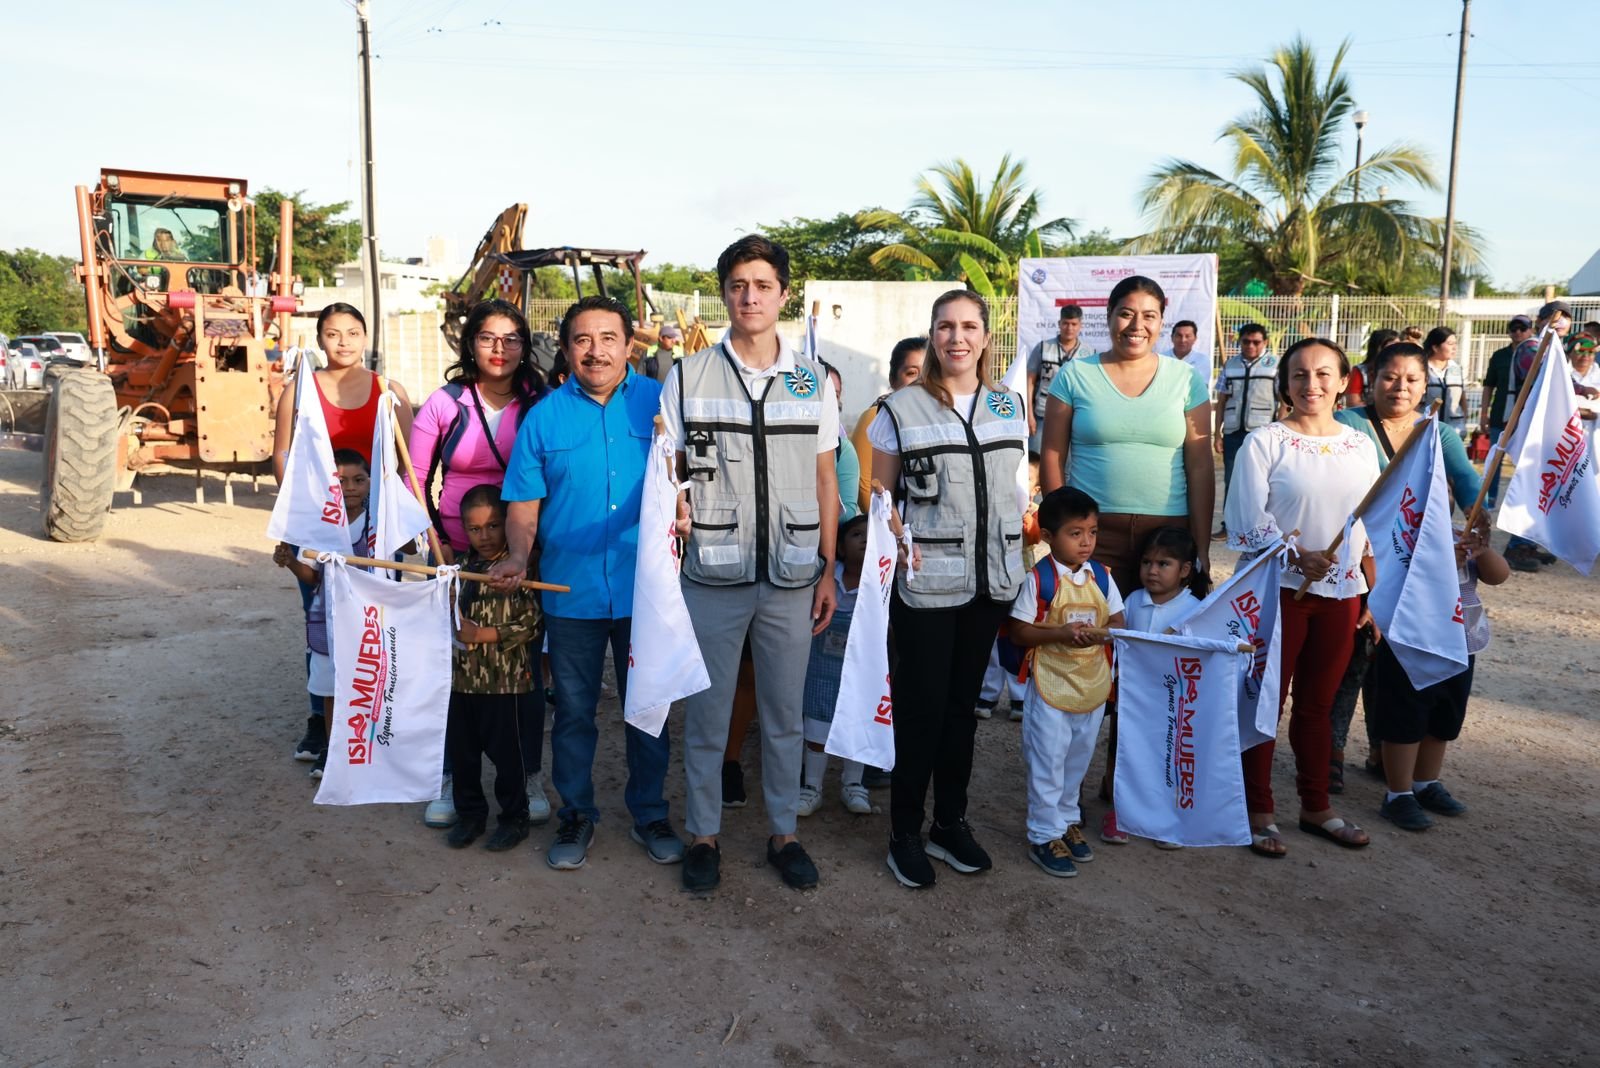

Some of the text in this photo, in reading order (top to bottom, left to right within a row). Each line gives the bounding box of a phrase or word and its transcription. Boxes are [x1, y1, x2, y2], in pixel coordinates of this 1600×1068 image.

[1538, 471, 1560, 513] ISLA
[348, 605, 381, 765] ISLA MUJERES
[377, 626, 398, 747] Sigamos Transformando
[1164, 673, 1178, 788] Sigamos Transformando
[1180, 657, 1201, 704] ISLA
[1179, 709, 1196, 810] MUJERES
